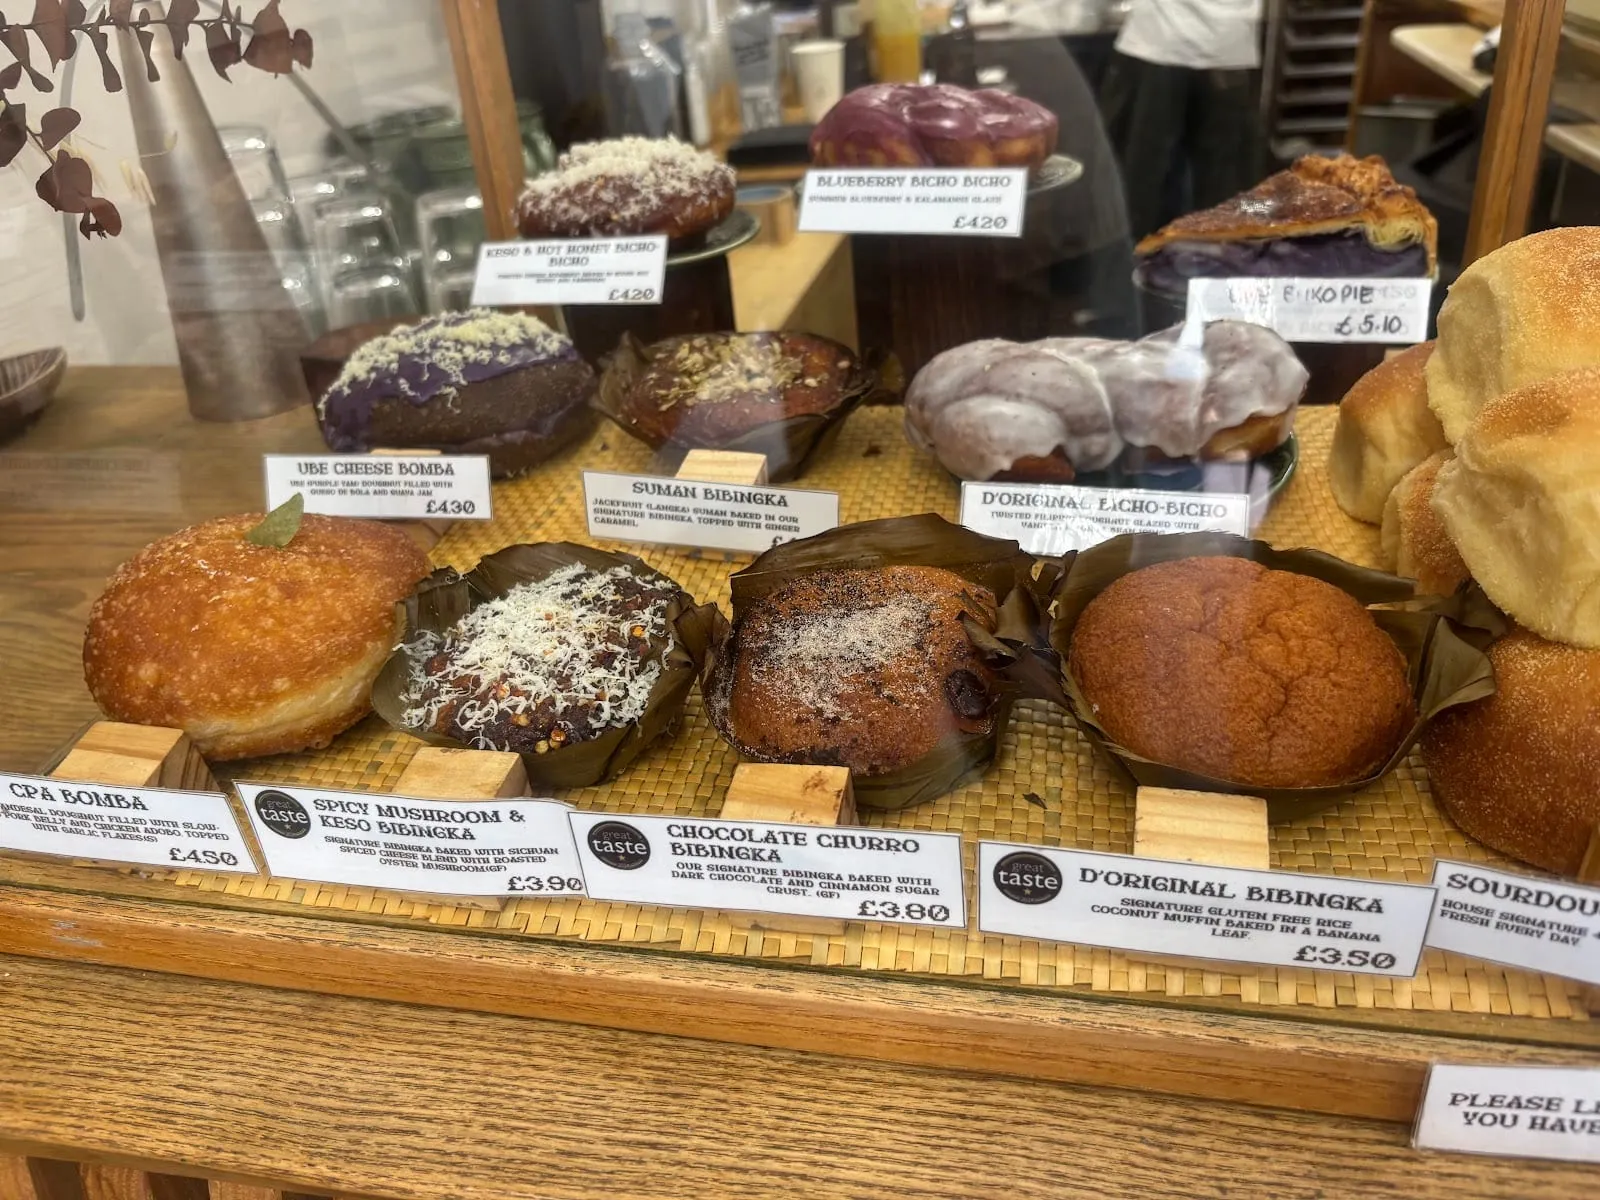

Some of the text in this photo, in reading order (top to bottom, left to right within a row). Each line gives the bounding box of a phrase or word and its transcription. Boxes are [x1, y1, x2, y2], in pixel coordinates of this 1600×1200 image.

[816, 175, 1012, 188] BLUEBERRY BICHO BICHO
[486, 248, 521, 259] KESO
[537, 245, 563, 256] HOT
[566, 243, 612, 255] HONEY
[548, 257, 590, 268] BICHO
[298, 462, 455, 476] UBE CHEESE BOMBA
[632, 482, 789, 508] SUMAN BIBINGKA
[697, 516, 734, 528] TOPPED
[736, 520, 762, 530] WITH
[764, 523, 801, 533] GINGER
[730, 511, 762, 520] BAKED
[778, 515, 799, 524] OUR
[991, 511, 1032, 520] TWISTED
[9, 782, 149, 811] CPA BOMBA
[48, 808, 105, 822] DOUGHNUT
[107, 815, 148, 826] FILLED
[149, 818, 180, 829] WITH
[260, 807, 309, 825] taste
[313, 799, 526, 824] SPICY MUSHROOM &
[31, 822, 61, 834] WITH
[33, 815, 66, 826] BELLY
[69, 819, 91, 829] AND
[93, 822, 141, 834] CHICKEN
[185, 830, 231, 842] TOPPED
[319, 815, 477, 841] KESO BIBINGKA
[602, 830, 632, 841] great
[666, 823, 920, 854] CHOCOLATE CHURRO
[324, 835, 560, 857] SIGNATURE BIBINGKA BAKED WITH SICHUAN
[339, 845, 548, 865] SPICED CHEESE BLEND WITH ROASTED
[591, 839, 648, 856] taste
[669, 841, 783, 864] BIBINGKA
[379, 857, 419, 869] OYSTER
[1011, 861, 1044, 873] great
[507, 875, 584, 892] £3.90
[671, 870, 940, 896] DARK CHOCOLATE AND CINNAMON SUGAR
[676, 861, 932, 887] OUR SIGNATURE BIBINGKA BAKED WITH
[998, 869, 1059, 890] taste
[815, 890, 841, 899] (GF)
[1078, 867, 1384, 914] D'ORIGINAL BIBINGKA
[1446, 873, 1600, 917] SOURDOU
[857, 899, 950, 923] £3.80
[1120, 897, 1352, 929] SIGNATURE GLUTEN FREE RICE
[1443, 899, 1495, 917] HOUSE
[1499, 912, 1588, 937] SIGNATURE
[1091, 904, 1382, 943] COCONUT MUFFIN BAKED IN A BANANA
[1439, 908, 1490, 929] FRESH
[1494, 922, 1545, 940] EVERY
[1292, 944, 1397, 970] £3.50
[1448, 1092, 1565, 1113] PLEASE
[1463, 1111, 1518, 1129] YOU
